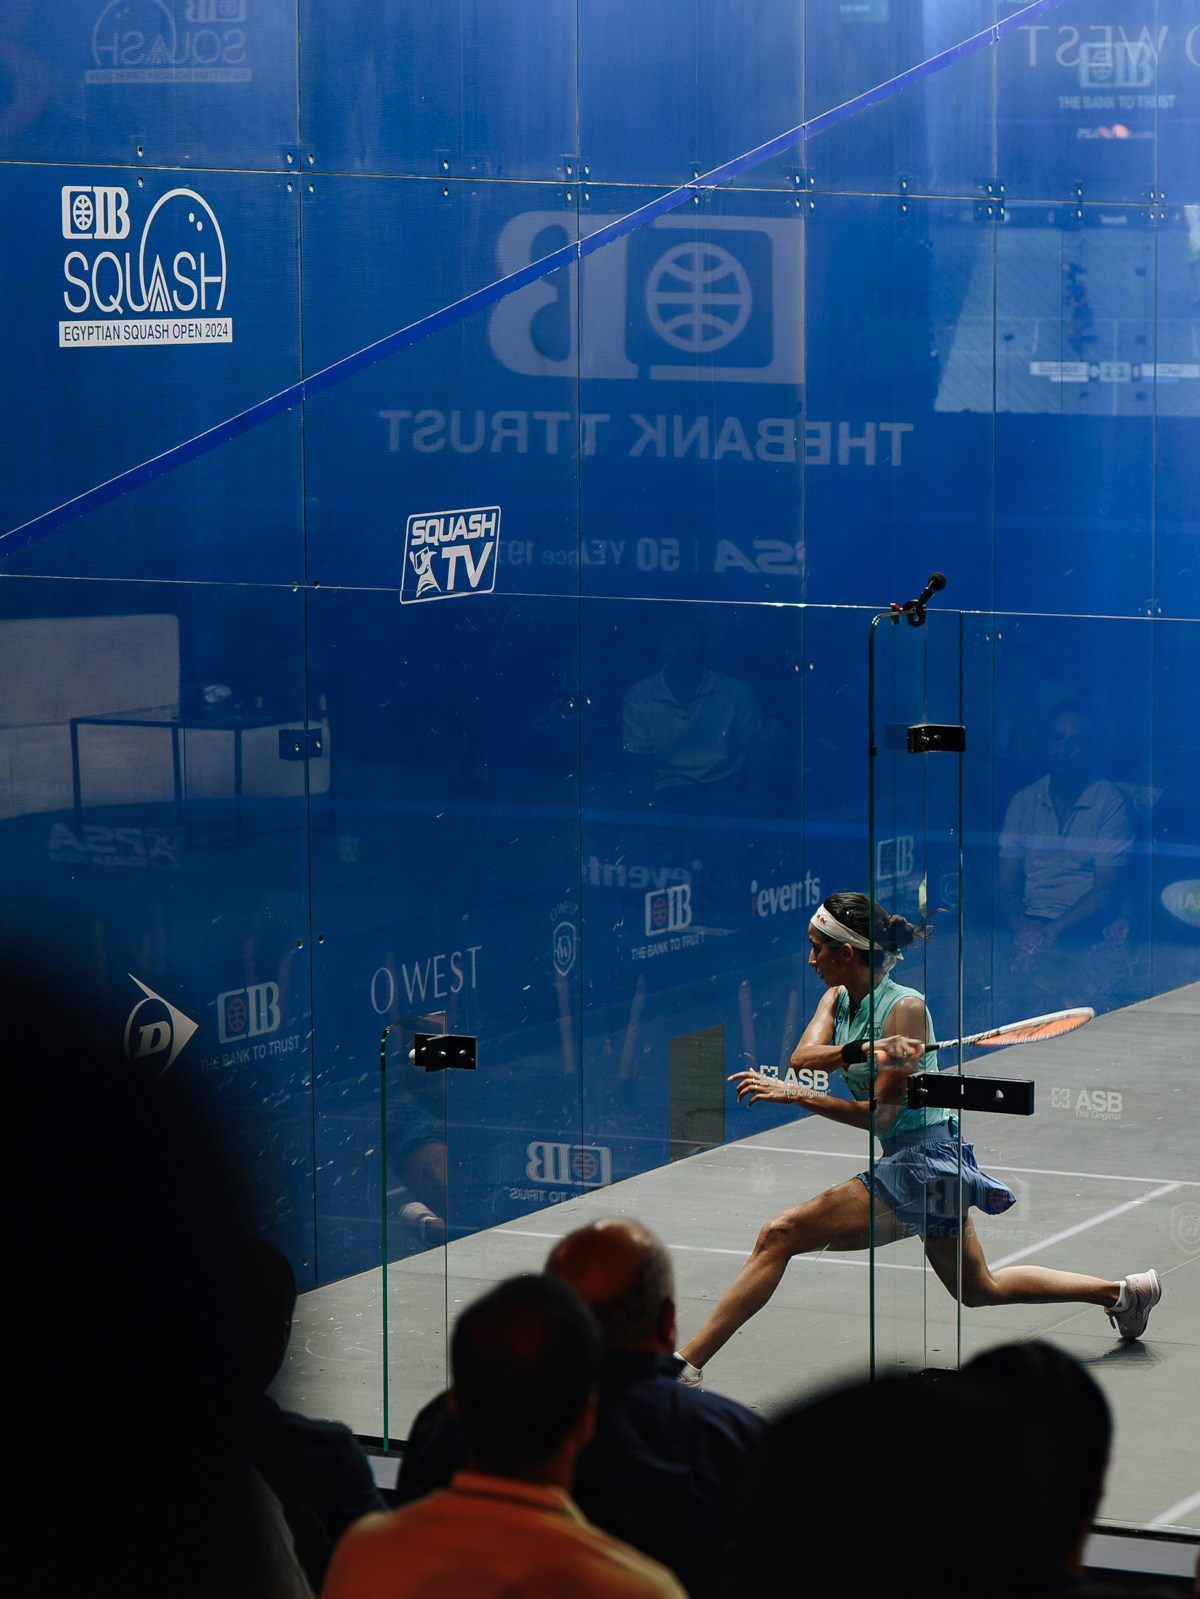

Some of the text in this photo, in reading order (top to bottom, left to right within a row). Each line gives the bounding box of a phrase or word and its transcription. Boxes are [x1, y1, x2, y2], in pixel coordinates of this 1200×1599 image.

[62, 186, 131, 240] CIB
[64, 251, 227, 315] SQUASH
[64, 322, 229, 342] EGYPTIAN SQUASH OPEN 2024
[411, 512, 497, 547] SQUASH
[441, 541, 494, 591] TV
[371, 945, 483, 1014] O WEST
[222, 1047, 250, 1067] BANK
[252, 1043, 267, 1061] TO
[268, 1035, 300, 1056] TRUST
[783, 1068, 829, 1091] ASB
[783, 1088, 797, 1097] The
[1075, 1089, 1123, 1113] ASB
[1075, 1109, 1122, 1121] The Original
